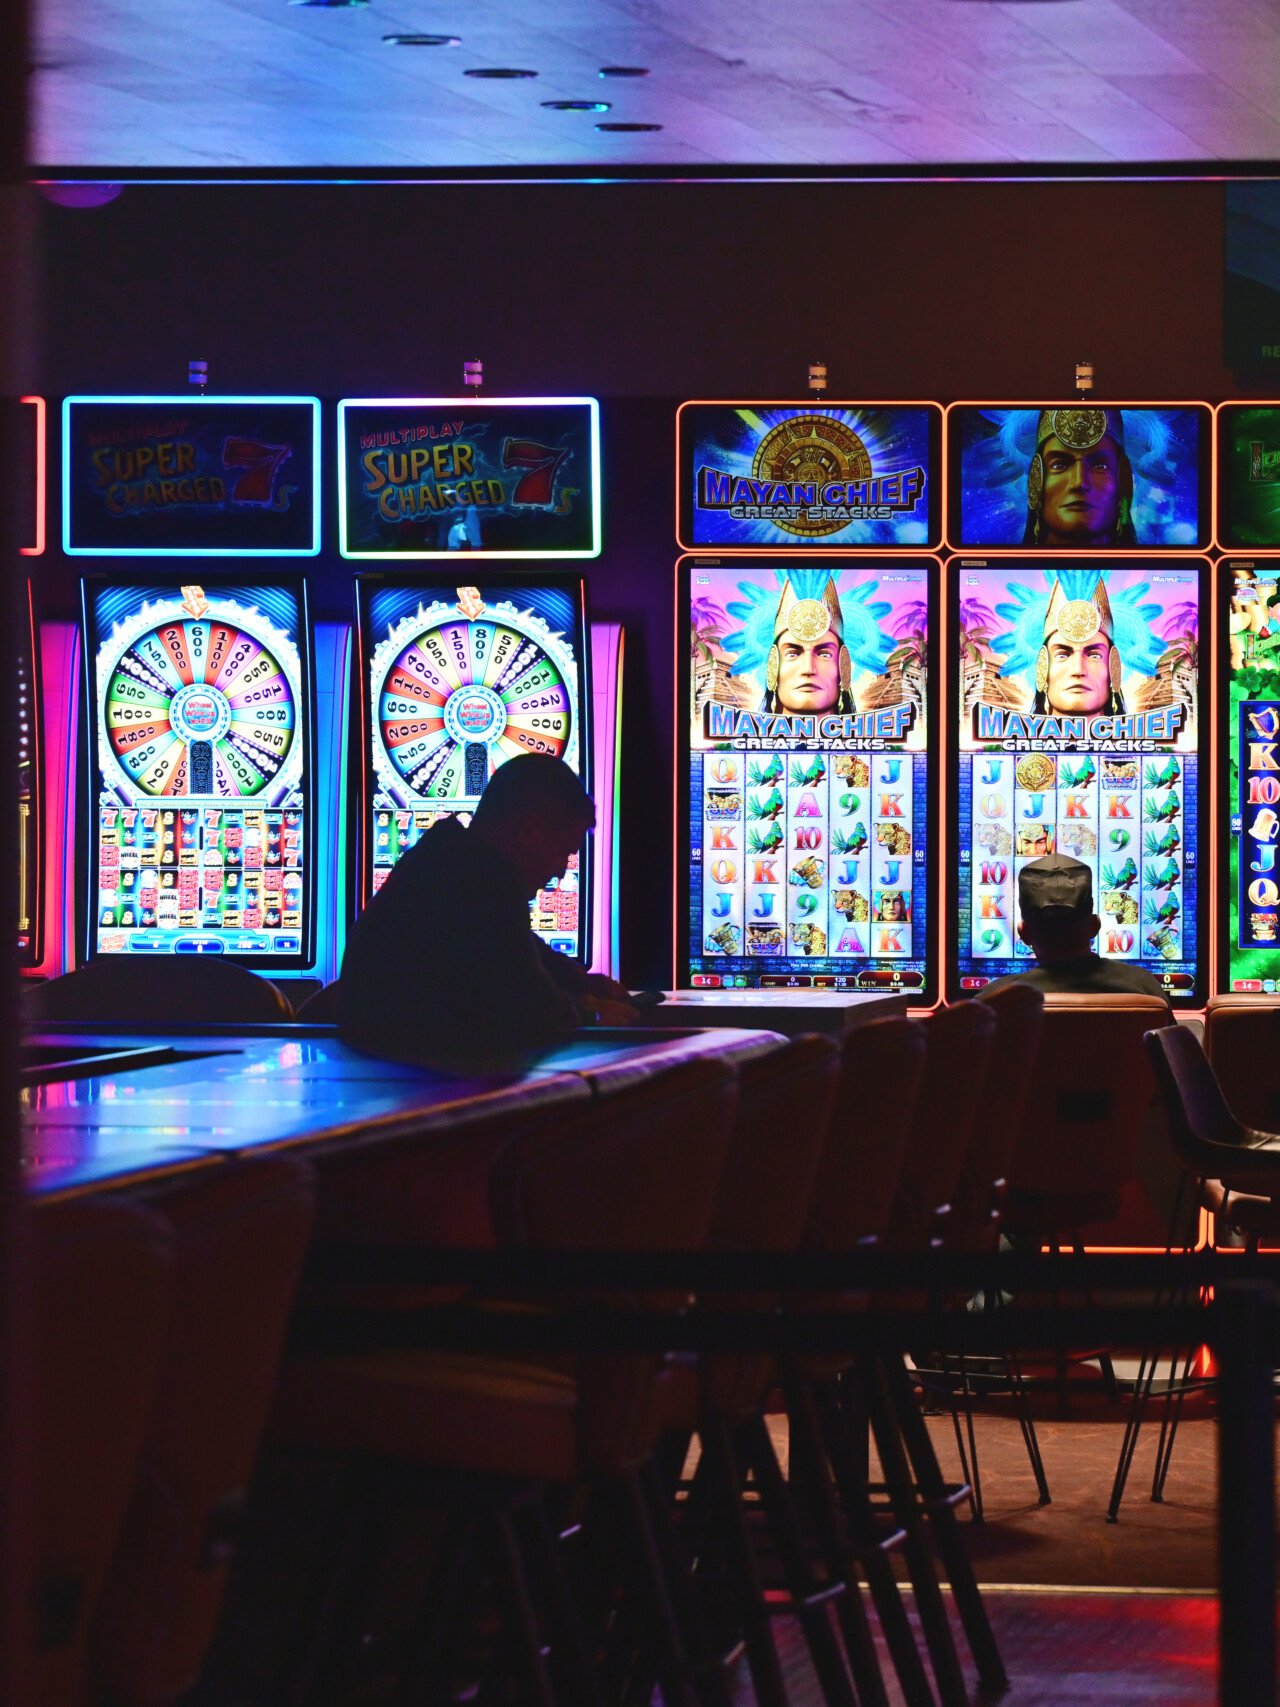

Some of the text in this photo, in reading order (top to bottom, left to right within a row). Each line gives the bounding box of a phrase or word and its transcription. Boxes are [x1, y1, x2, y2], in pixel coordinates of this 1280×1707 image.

[360, 421, 464, 449] MULTIPLAY
[91, 442, 196, 487] SUPER
[362, 443, 475, 491] SUPER
[106, 477, 226, 513] CHARGED
[379, 480, 506, 518] CHARGED
[705, 468, 920, 506] MAYAN CHIEF
[730, 506, 892, 519] GREAT STACKS
[166, 630, 186, 669] 2000
[191, 627, 203, 657] 600
[211, 631, 228, 669] 1100
[450, 630, 467, 669] 1500
[475, 629, 487, 659] 800
[113, 709, 152, 719] 1000
[710, 704, 912, 738] MAYAN CHIEF
[978, 705, 1183, 739] MAYAN CHIEF
[733, 738, 885, 750] GREAT STACKS
[1002, 739, 1156, 751] GREAT STACKS
[880, 759, 903, 784] J
[1063, 794, 1091, 819] K
